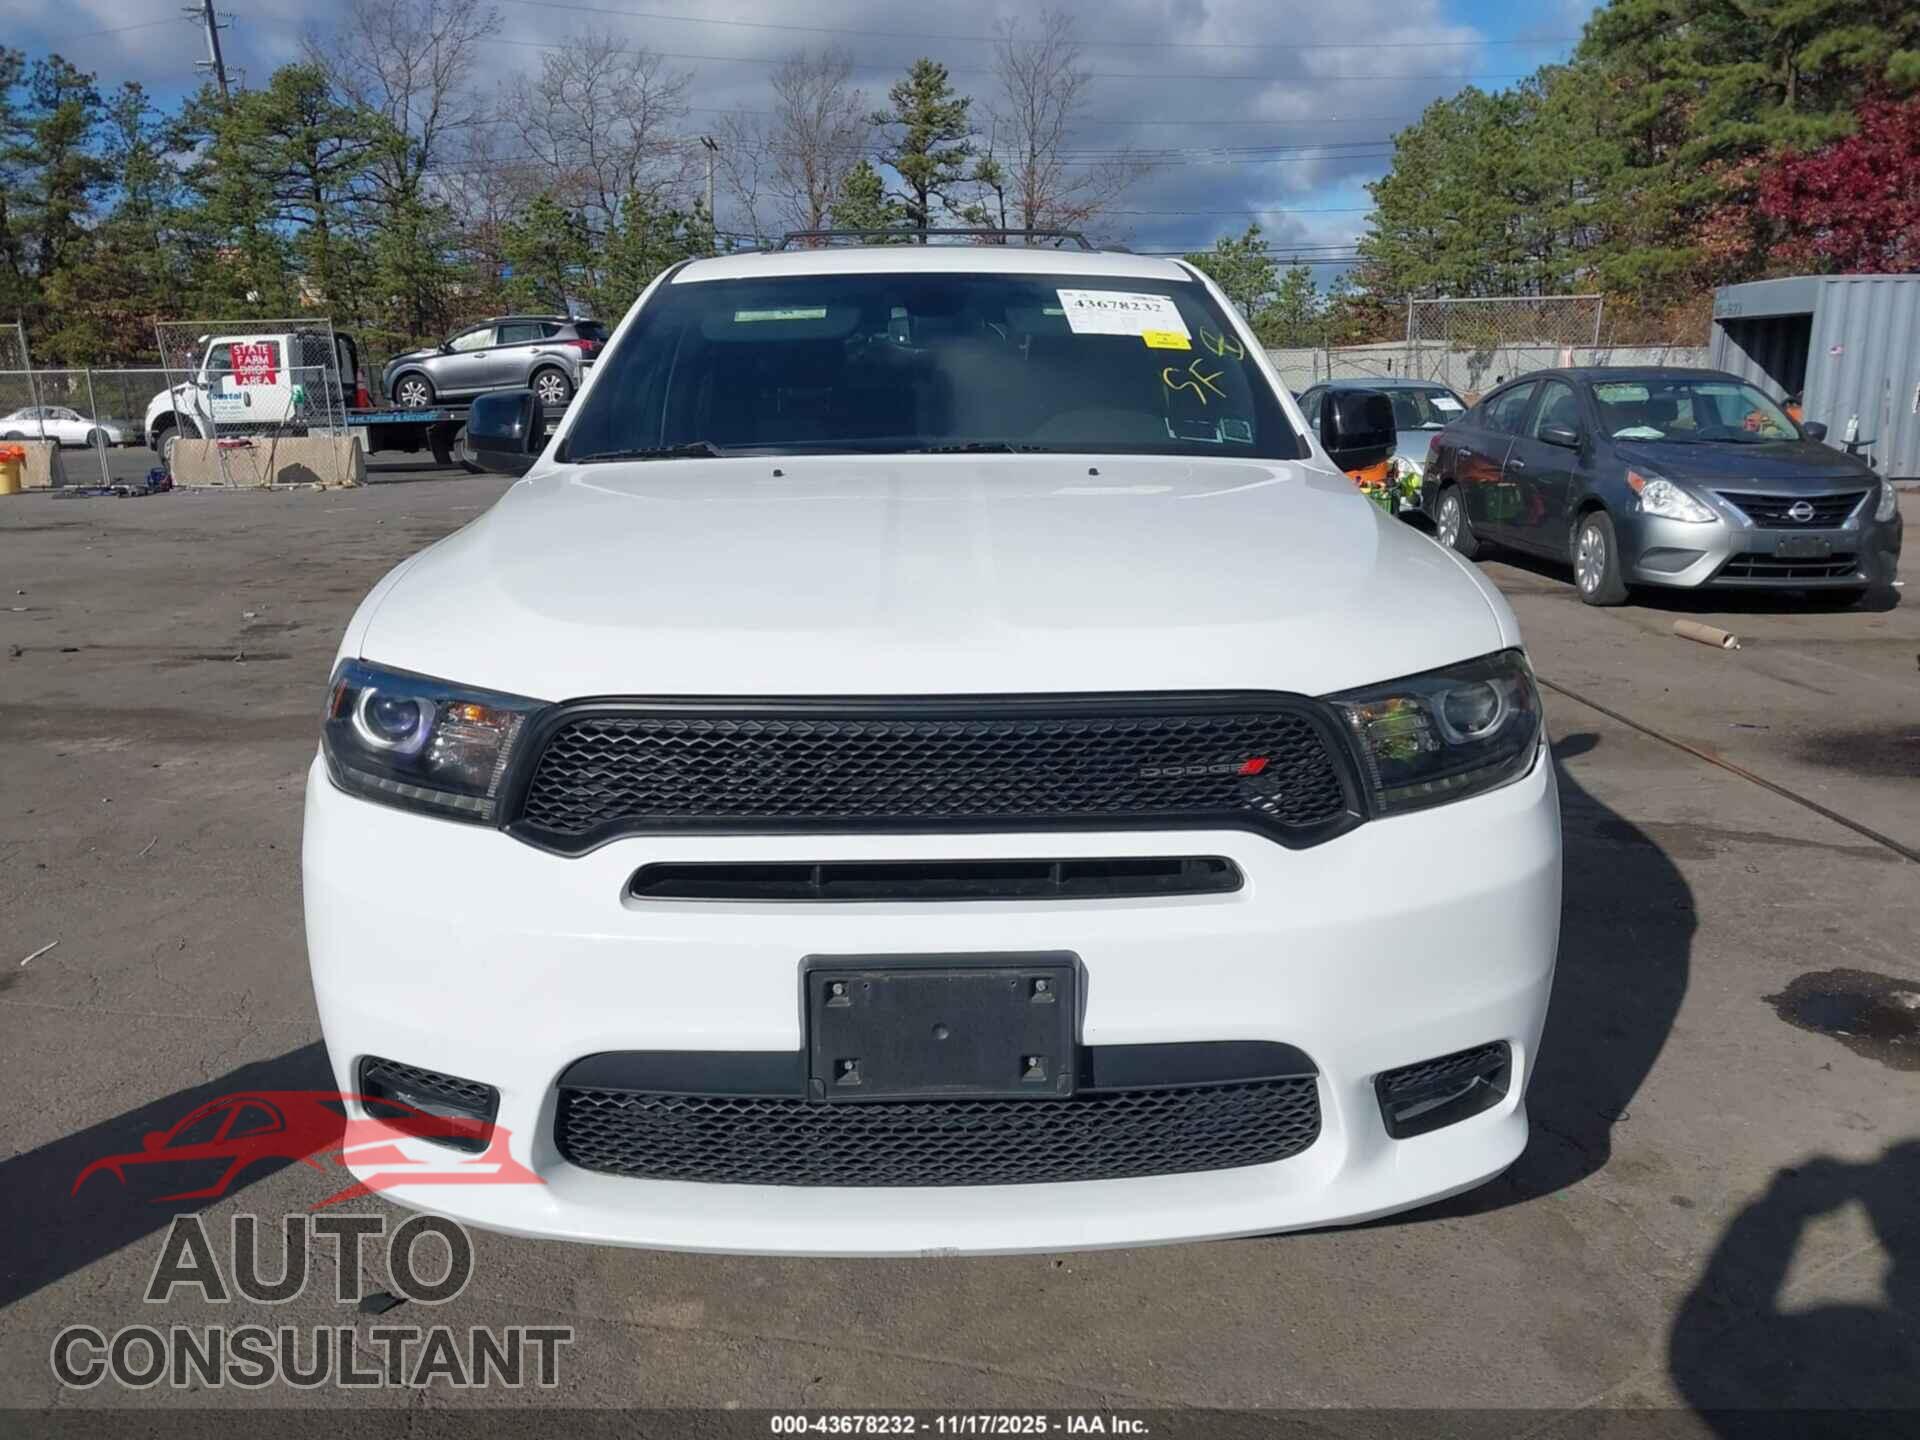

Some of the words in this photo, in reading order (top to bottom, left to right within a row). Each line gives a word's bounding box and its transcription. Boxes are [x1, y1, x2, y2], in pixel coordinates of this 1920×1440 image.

[1074, 299, 1162, 313] 43678232
[233, 344, 270, 354] STATE
[237, 355, 270, 365] FARM
[240, 365, 271, 376] DROP
[241, 376, 272, 385] AREA
